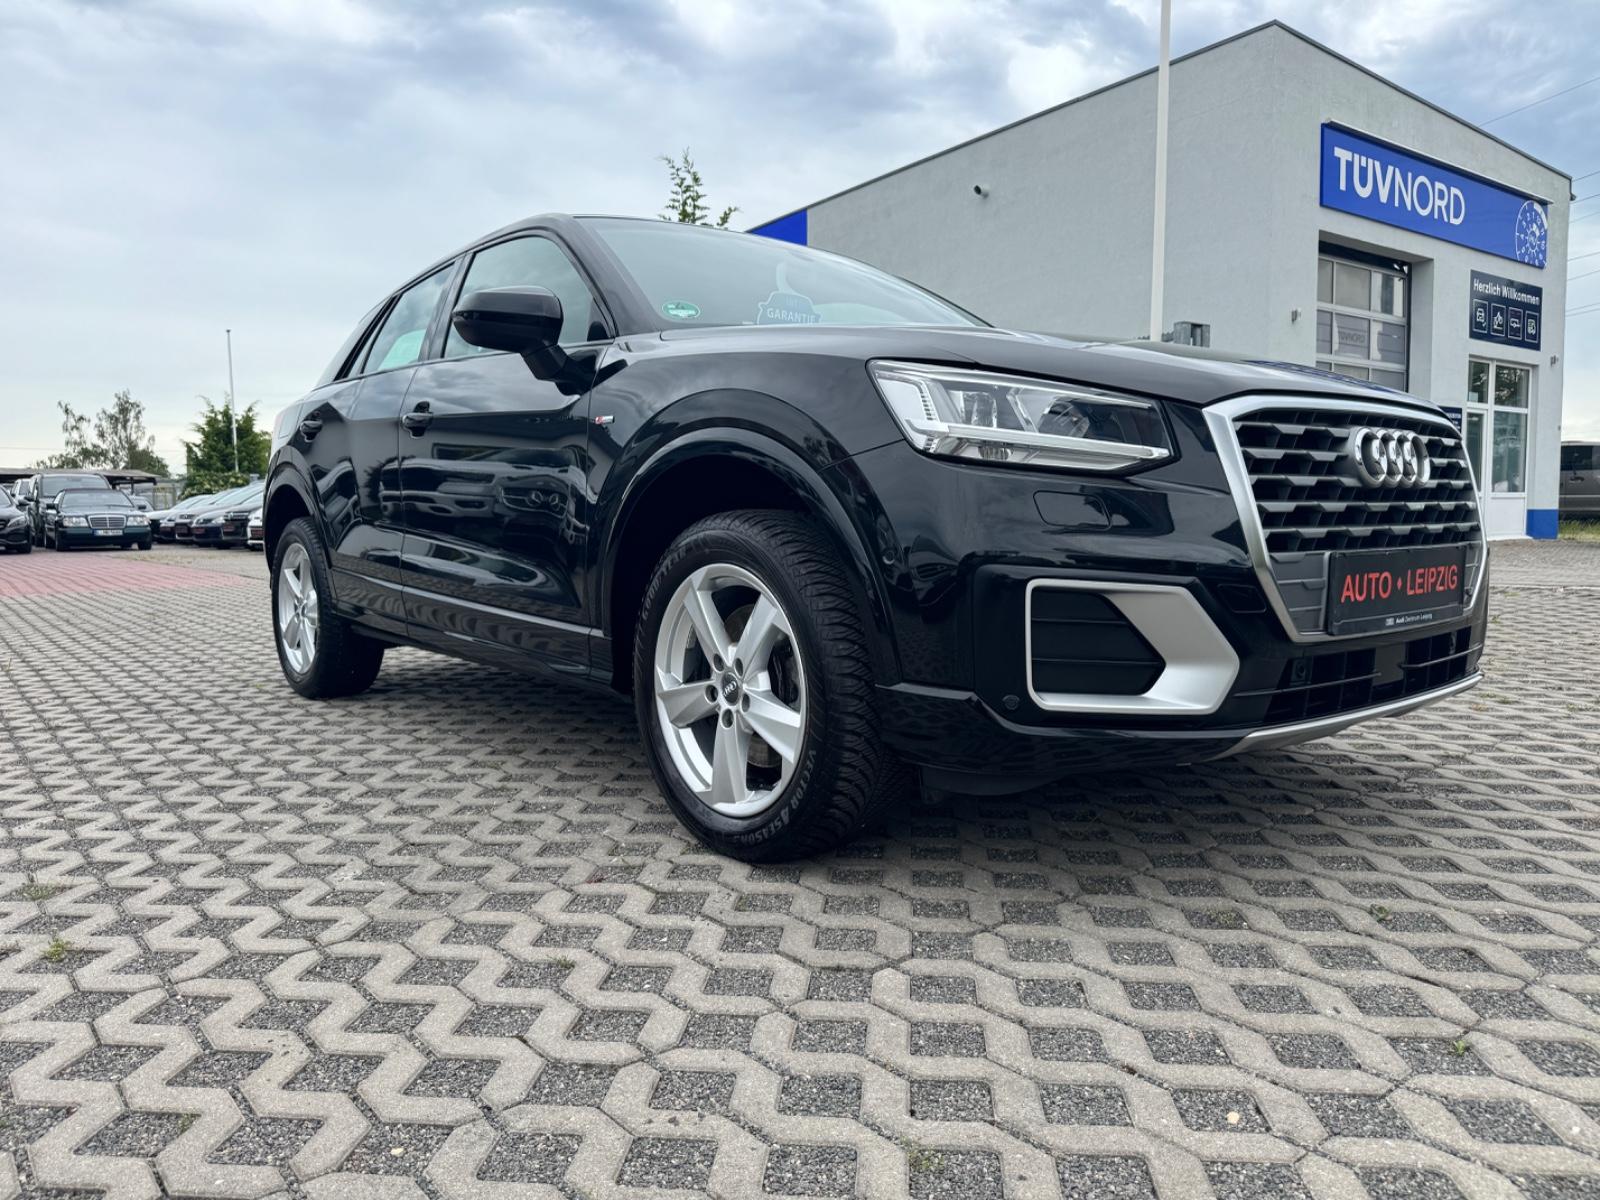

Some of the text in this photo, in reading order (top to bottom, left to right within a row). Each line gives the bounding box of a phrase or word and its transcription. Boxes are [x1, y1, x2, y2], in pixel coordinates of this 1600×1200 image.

[1473, 278, 1540, 305] Herzlich Willkommen
[1340, 564, 1458, 603] AUTO LEIPZIG
